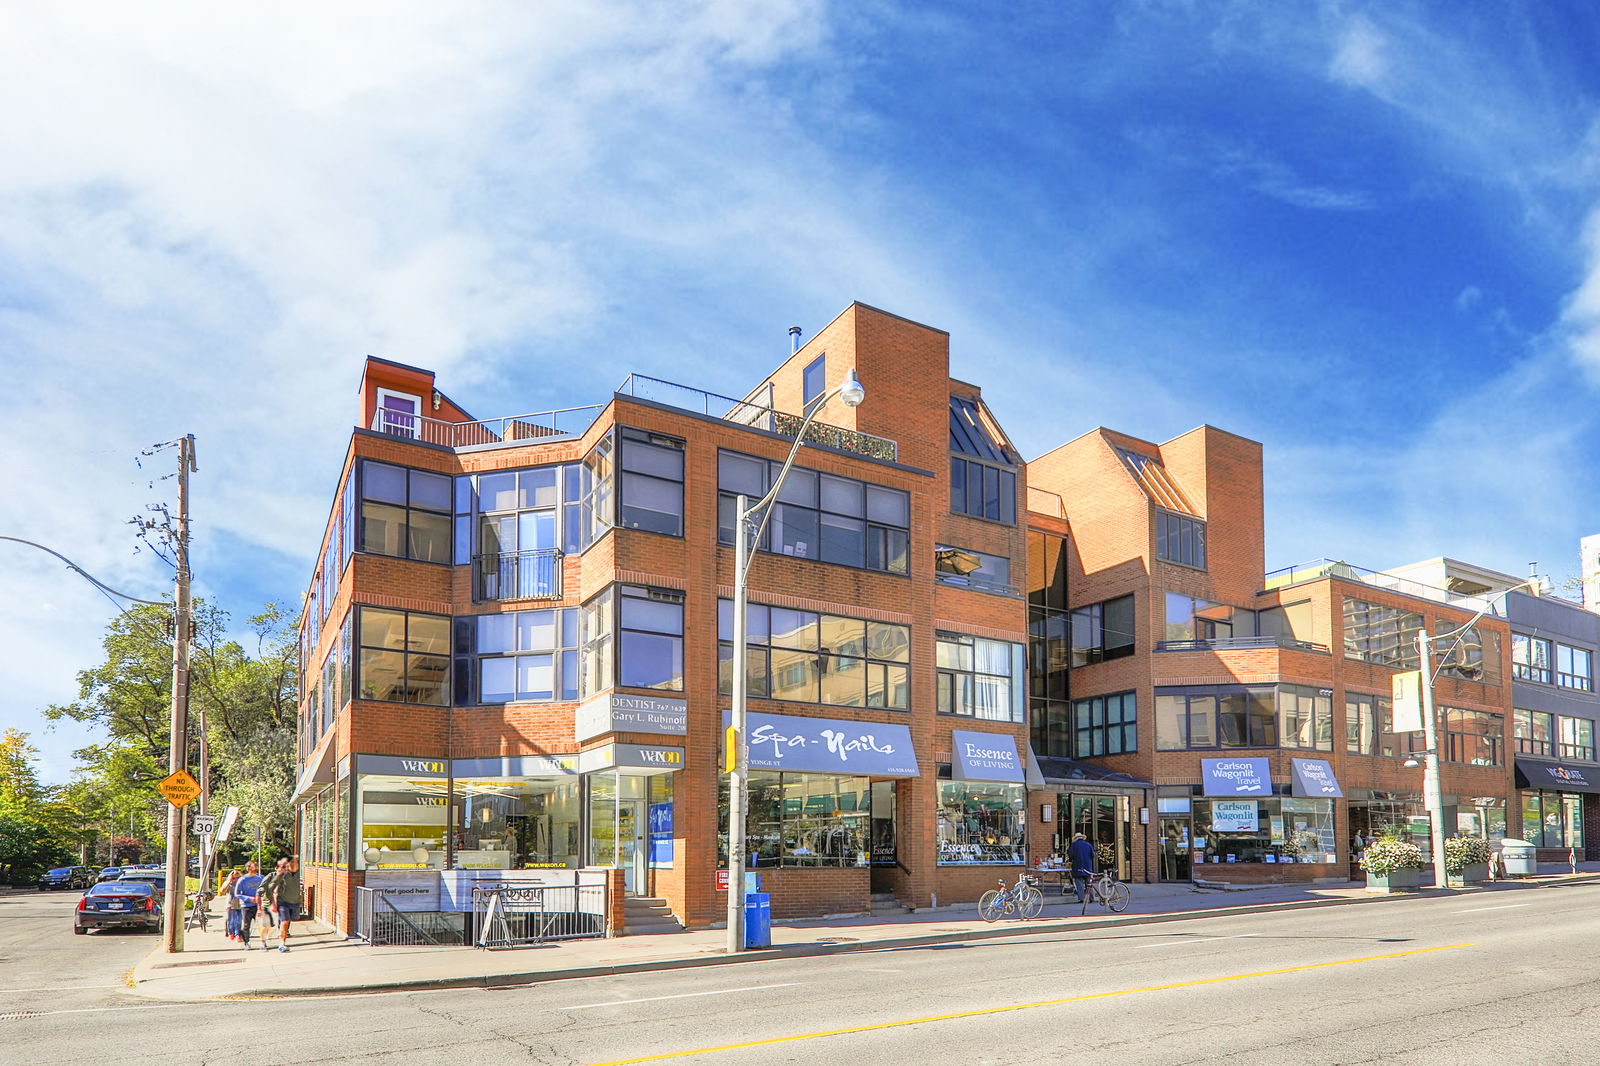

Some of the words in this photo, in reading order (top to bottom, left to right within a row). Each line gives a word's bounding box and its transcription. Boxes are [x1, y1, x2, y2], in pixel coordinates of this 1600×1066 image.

[612, 697, 656, 709] DENTIST
[611, 711, 635, 723] Gary
[637, 713, 645, 722] L.
[648, 714, 687, 725] Rubinoff
[640, 750, 680, 763] waxon
[964, 743, 1013, 760] Essence
[401, 760, 445, 773] waxon
[750, 759, 772, 767] YONGE
[983, 760, 1014, 769] LIVING
[1216, 762, 1253, 770] Carlson
[1302, 762, 1323, 772] Carlson
[1212, 769, 1254, 779] Wagonlit
[1236, 777, 1261, 785] Travel
[165, 785, 195, 793] THROUGH
[416, 797, 448, 806] waxon
[1217, 802, 1251, 811] Carlson
[1215, 811, 1253, 821] Wagonlit
[196, 823, 213, 833] 30
[873, 846, 895, 855] Essence
[940, 840, 976, 853] Essence
[951, 853, 975, 861] LIVING
